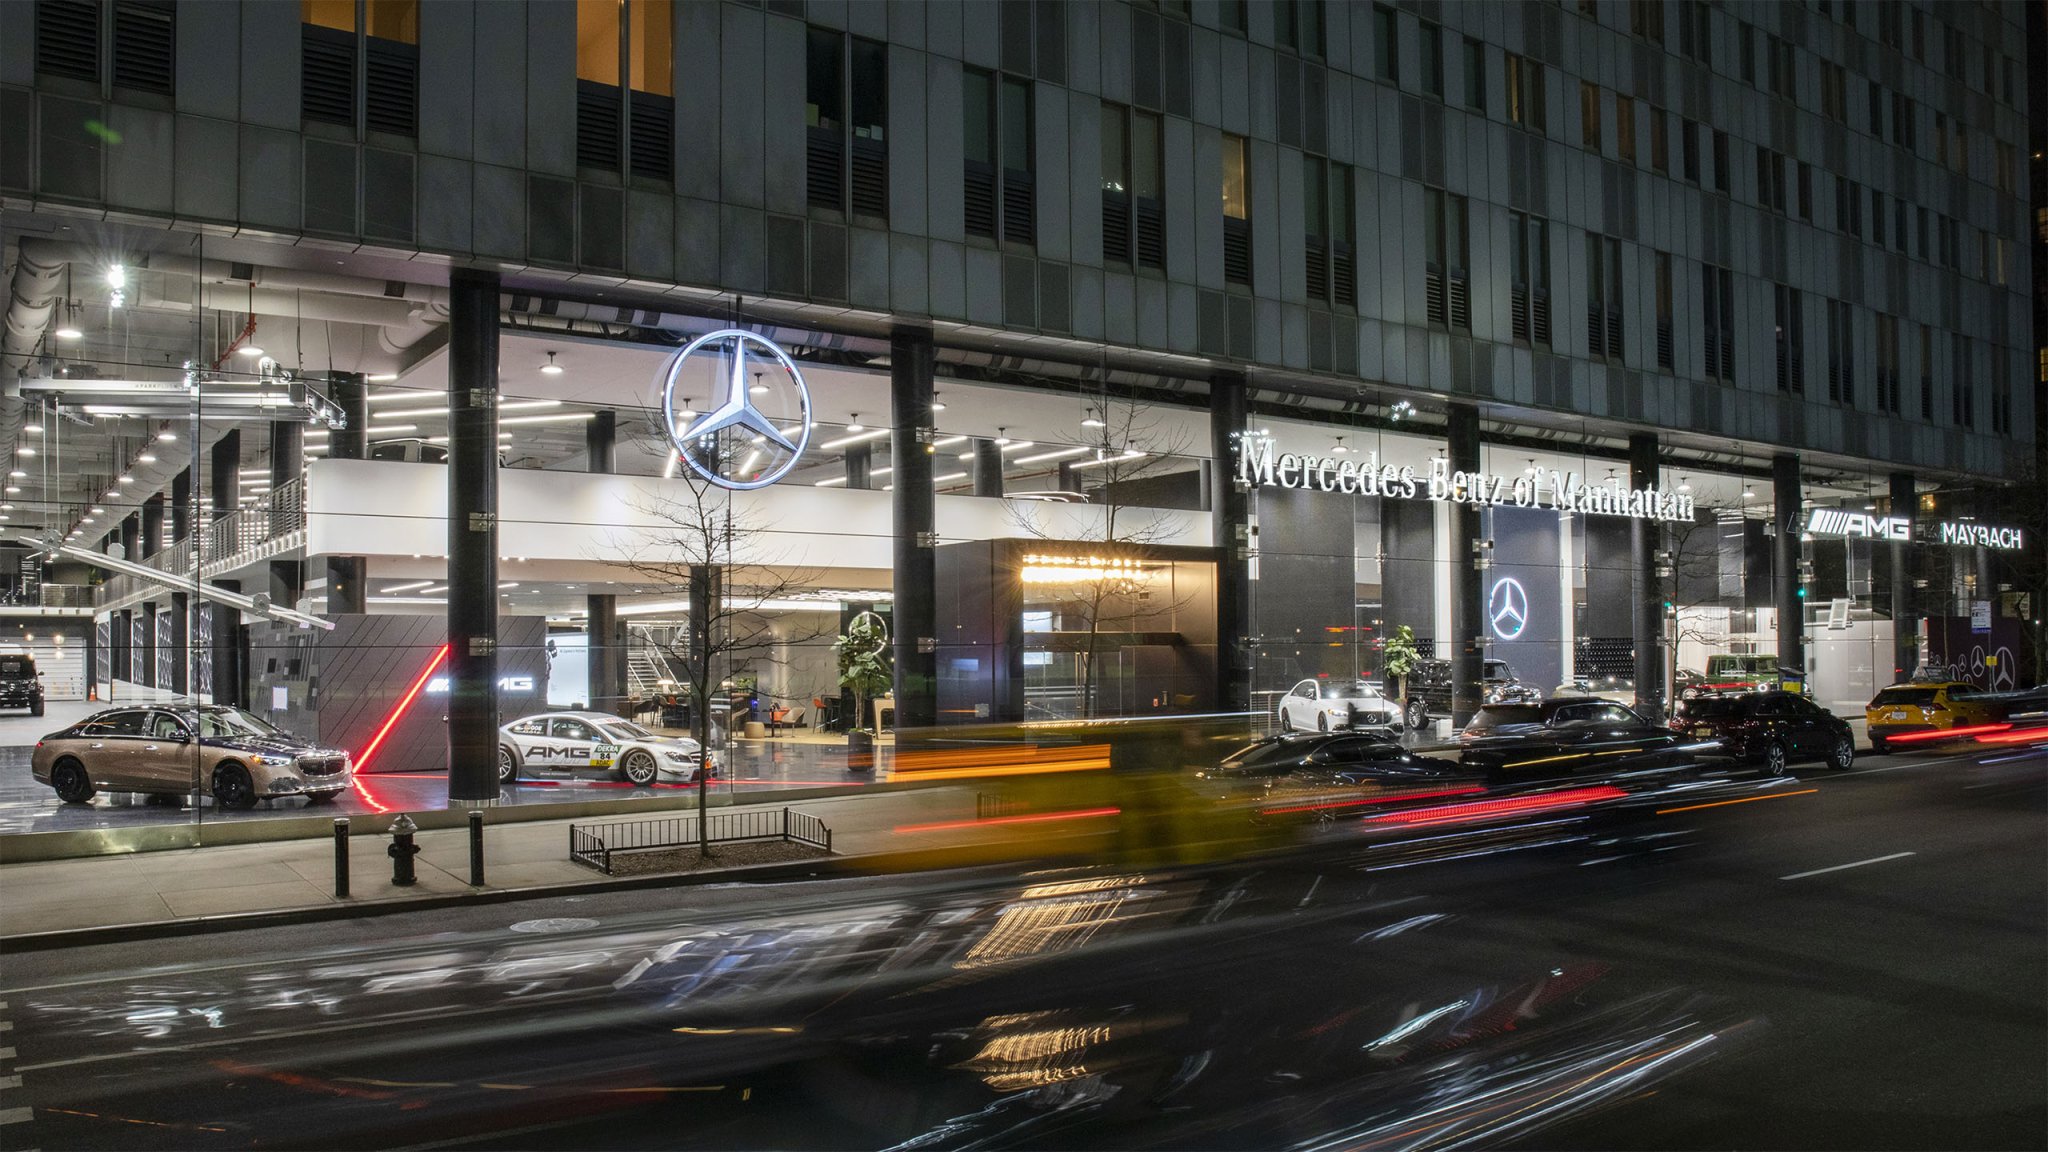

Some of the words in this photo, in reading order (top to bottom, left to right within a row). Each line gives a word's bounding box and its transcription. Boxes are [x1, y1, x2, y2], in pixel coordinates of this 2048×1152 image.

[1514, 466, 1545, 508] of
[1551, 469, 1696, 522] Manhattan
[1842, 513, 1910, 540] AMG
[1941, 522, 2022, 549] MAYBACH
[525, 746, 591, 758] AMG
